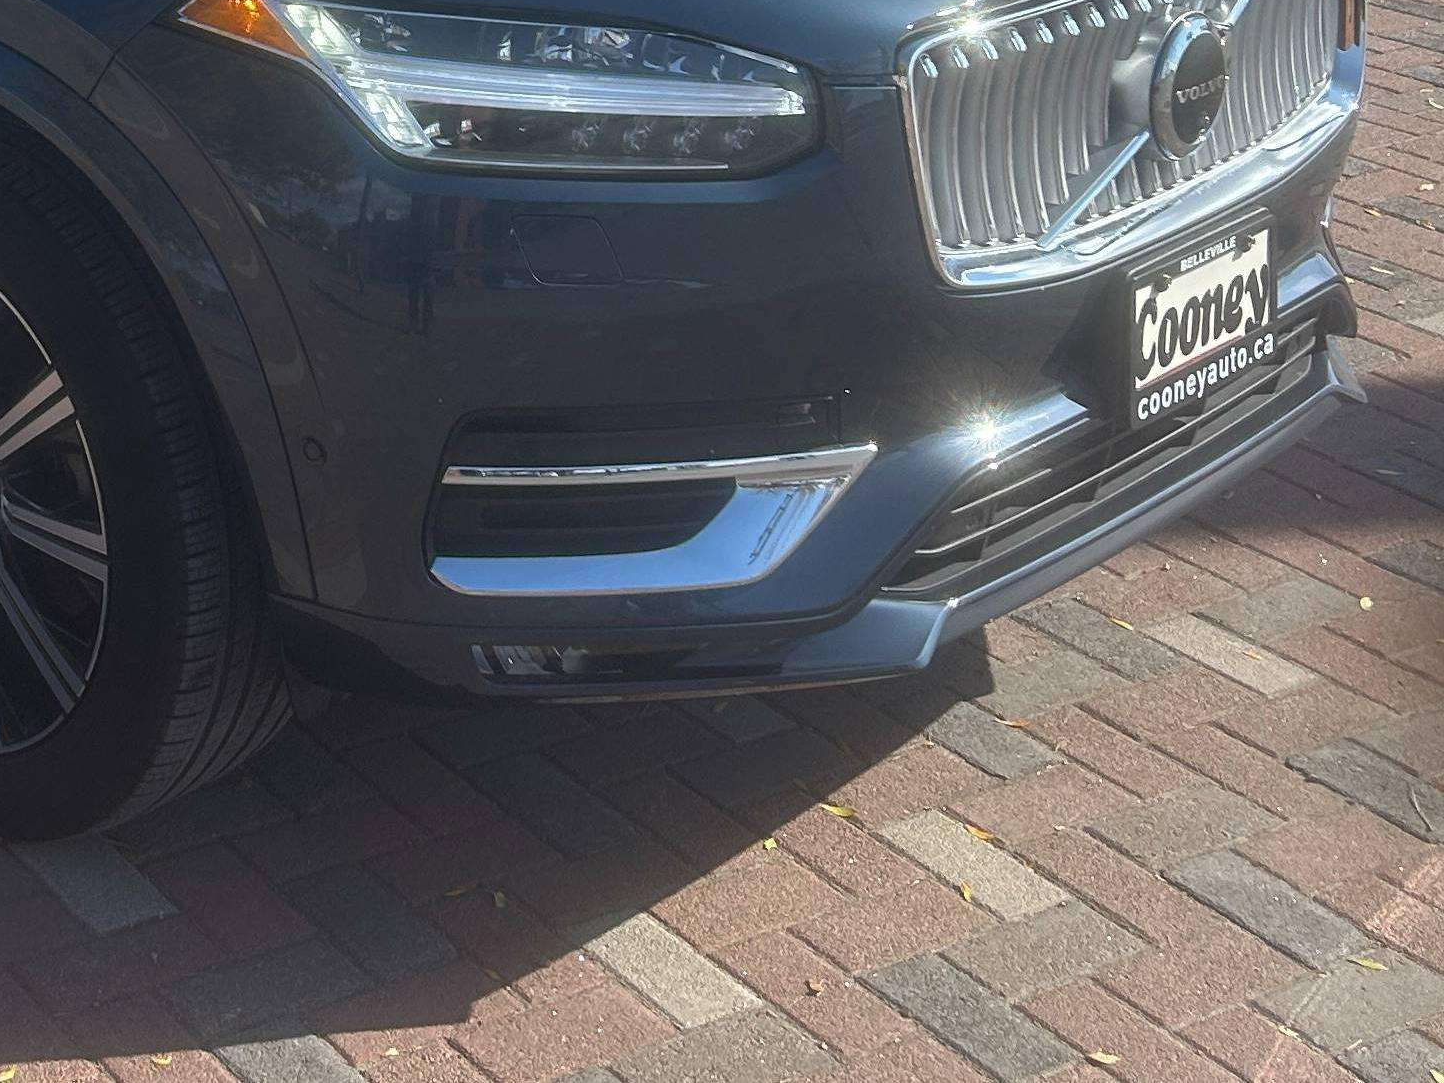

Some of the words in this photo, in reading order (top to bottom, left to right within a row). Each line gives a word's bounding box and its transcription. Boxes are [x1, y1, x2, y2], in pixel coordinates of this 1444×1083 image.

[1180, 235, 1237, 272] BELLEVILLE
[1135, 263, 1270, 381] Cooney
[1137, 332, 1274, 420] cooneyauto.ca
